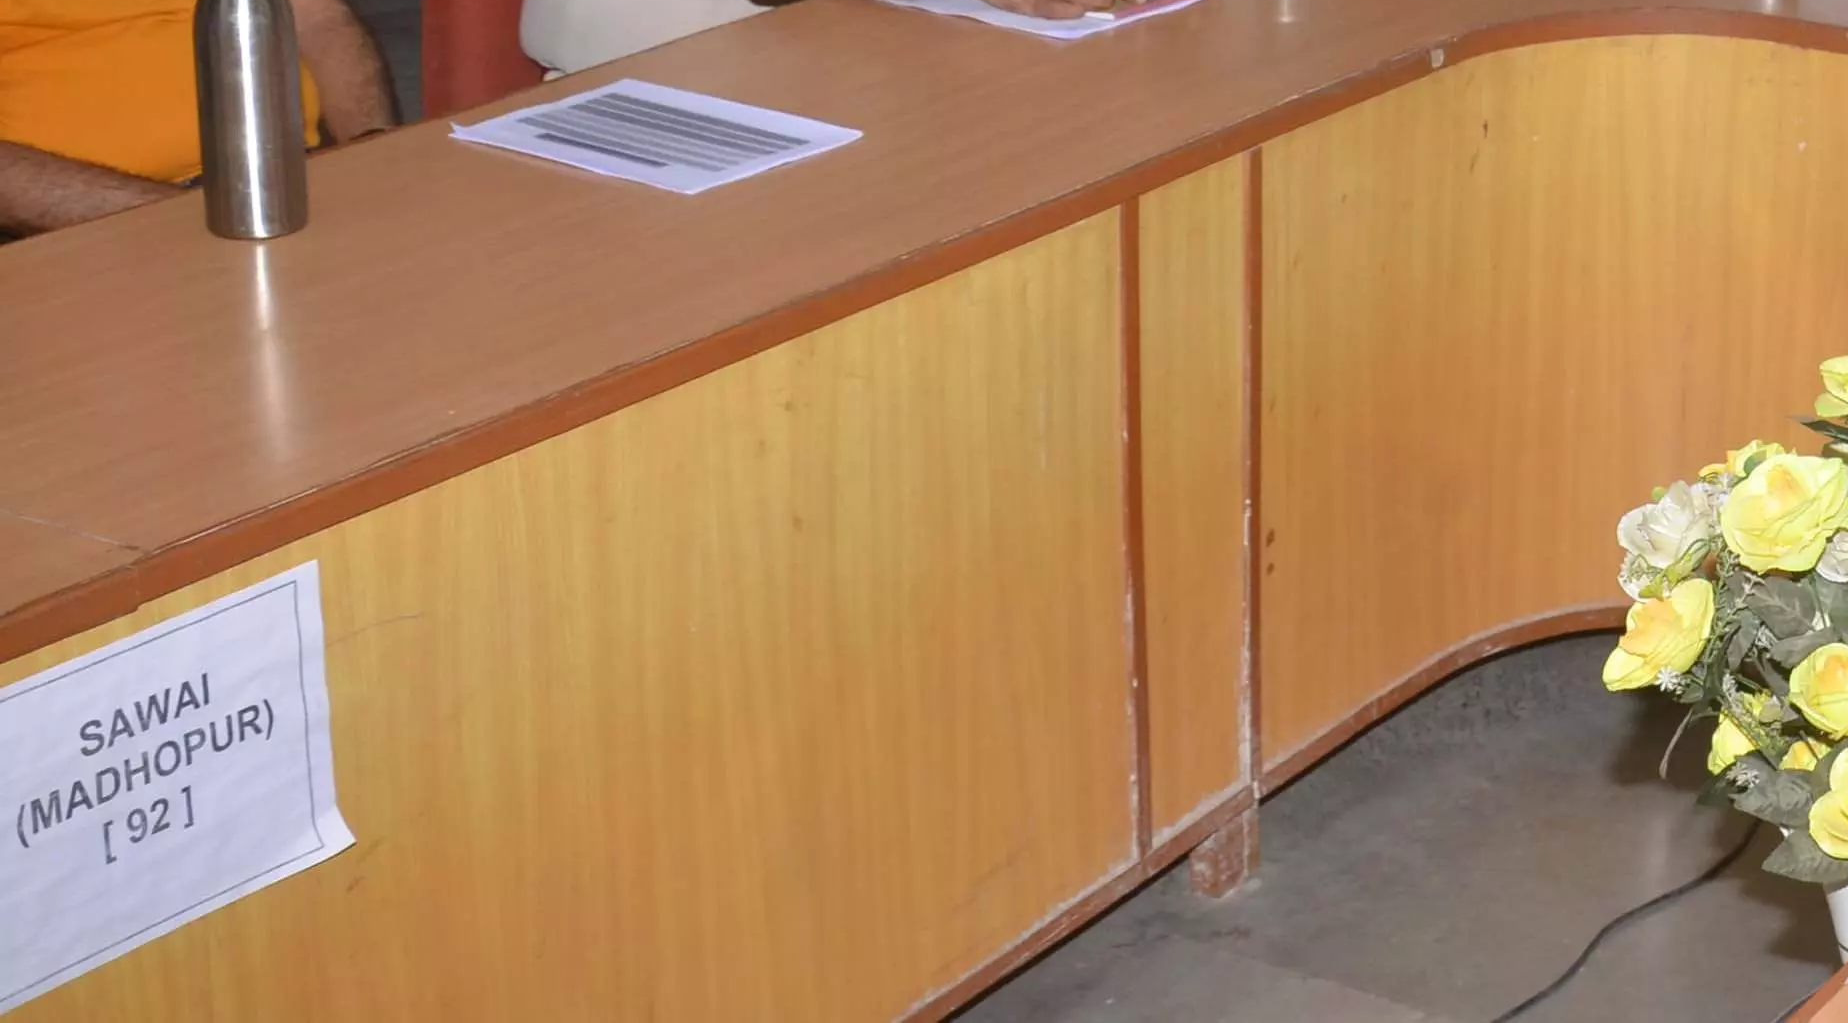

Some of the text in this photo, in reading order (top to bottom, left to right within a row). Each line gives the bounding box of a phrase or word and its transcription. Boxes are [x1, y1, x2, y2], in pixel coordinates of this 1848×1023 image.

[79, 673, 210, 757] SAWAI
[16, 699, 274, 848] (MADHOPUR)
[127, 797, 170, 844] 92
